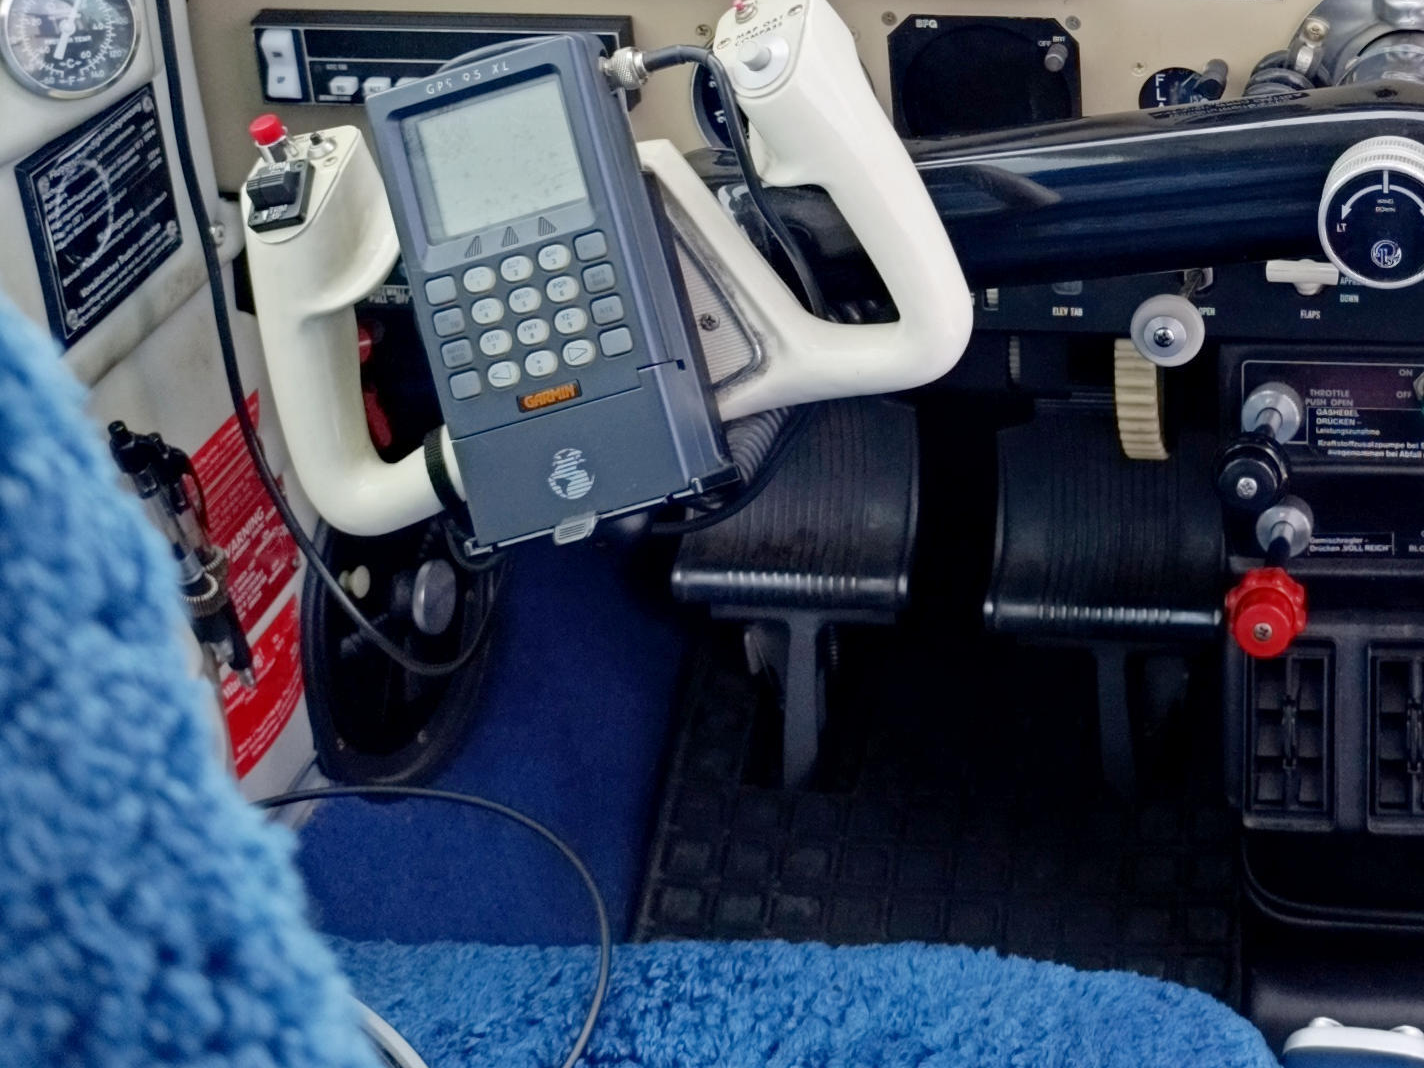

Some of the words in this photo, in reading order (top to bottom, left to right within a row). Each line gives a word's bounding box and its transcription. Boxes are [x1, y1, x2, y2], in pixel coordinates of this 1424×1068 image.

[426, 78, 452, 95] GPS
[463, 69, 481, 82] 95
[492, 61, 510, 75] XL
[1052, 306, 1069, 317] ELEV
[1070, 307, 1084, 317] TAB
[1299, 309, 1321, 320] FLAPS
[1398, 368, 1413, 377] ON
[523, 382, 576, 410] GARMIN
[1309, 388, 1350, 398] THROTTLE
[1396, 390, 1412, 399] OFF
[1304, 397, 1327, 406] PUSH
[1330, 398, 1354, 407] OPEN
